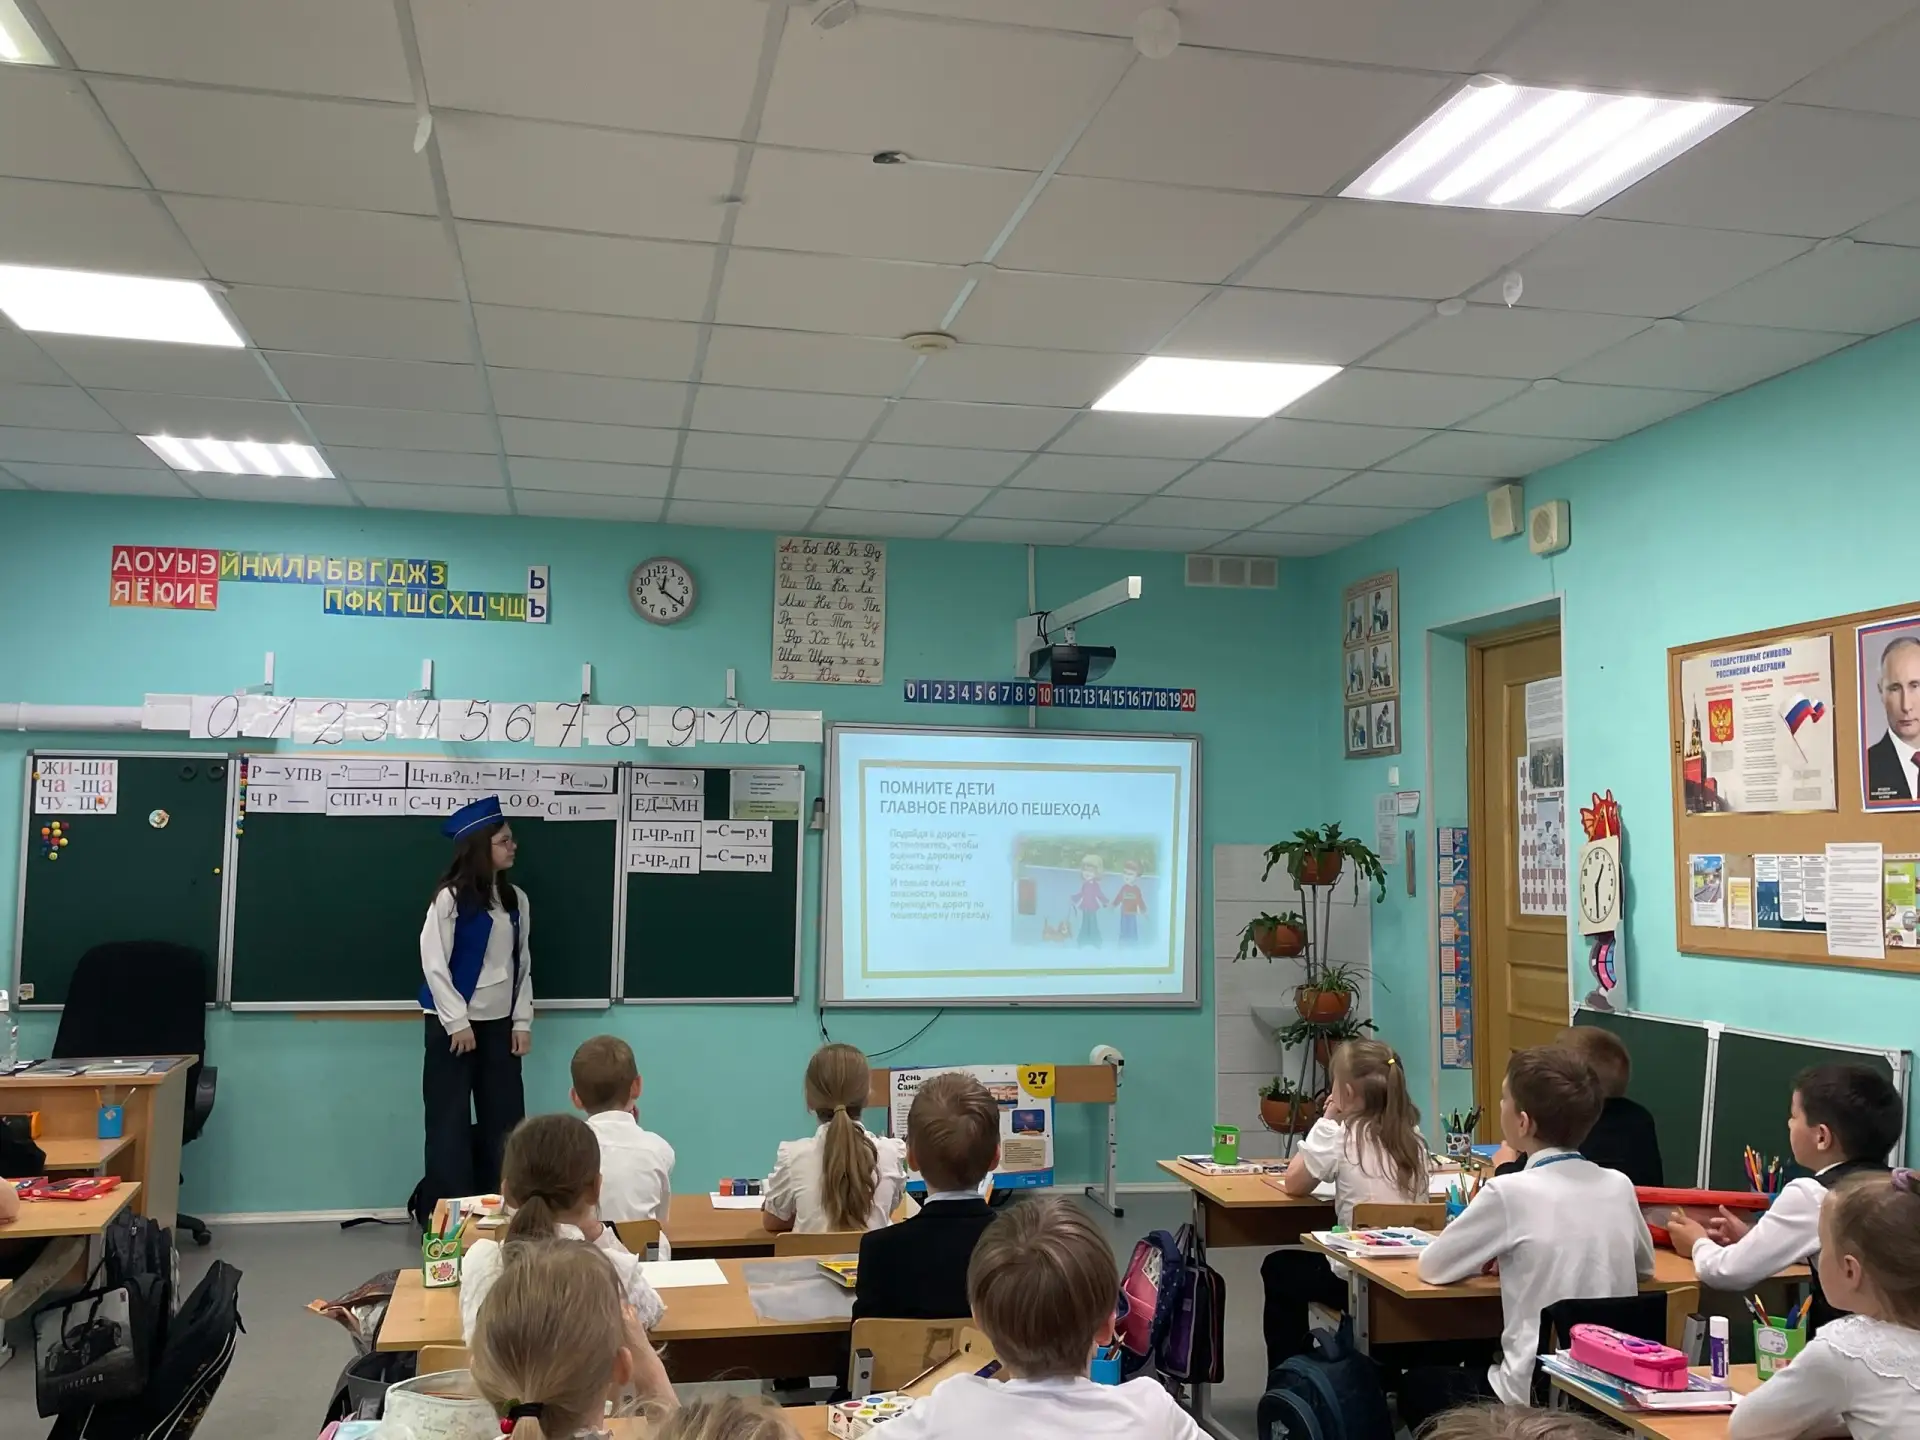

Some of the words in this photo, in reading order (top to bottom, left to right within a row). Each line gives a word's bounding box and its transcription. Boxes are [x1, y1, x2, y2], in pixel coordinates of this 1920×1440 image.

[647, 569, 657, 578] 11
[656, 565, 668, 574] 12
[670, 569, 676, 577] 1
[640, 577, 651, 586] 10
[677, 576, 684, 585] 2
[636, 587, 643, 595] 9
[682, 586, 689, 595] 3
[641, 596, 648, 605] 8
[649, 604, 656, 613] 7
[660, 608, 667, 617] 6
[672, 604, 678, 613] 5
[907, 681, 915, 699] 0
[921, 682, 928, 699] 1
[934, 683, 942, 700] 2
[948, 683, 956, 700] 3
[961, 683, 970, 700] 4
[974, 684, 982, 701] 5
[988, 684, 997, 701] 6
[1002, 685, 1010, 701] 7
[1015, 685, 1023, 701] 8
[1028, 684, 1036, 701] 9
[1039, 687, 1051, 703] 10
[1053, 686, 1065, 704] 11
[1068, 687, 1081, 704] 12
[1083, 687, 1096, 705] 13
[1098, 688, 1110, 705] 14
[1112, 689, 1125, 706] 15
[1127, 689, 1139, 706] 16
[1141, 690, 1153, 706] 17
[1154, 691, 1167, 707] 18
[1169, 691, 1181, 708] 19
[1182, 692, 1195, 708] 20
[208, 695, 239, 738] 0
[274, 697, 295, 738] 1
[312, 702, 345, 744] 2
[362, 702, 388, 741] 3
[416, 700, 439, 730] 4
[460, 700, 489, 742] 5
[506, 704, 531, 742] 6
[556, 703, 582, 747] 7
[606, 706, 636, 746] 8
[667, 706, 696, 746] 9
[712, 710, 771, 744] 10
[880, 780, 953, 795] ПОМНИТЕ
[955, 782, 995, 799] ДЕТИ
[880, 800, 946, 814] ГЛАВНОЕ
[950, 801, 1018, 815] ПРАВИЛО
[1021, 802, 1100, 819] ПЕШЕХОДА
[937, 831, 966, 840] дороге
[952, 840, 979, 849] чтобы
[890, 852, 925, 861] оценить
[927, 852, 973, 862] дорожную
[890, 879, 897, 887] И
[899, 879, 929, 887] только
[942, 901, 971, 910] дорогу
[890, 912, 949, 920] пешеходному
[897, 1073, 921, 1083] День
[1028, 1072, 1048, 1084] 27
